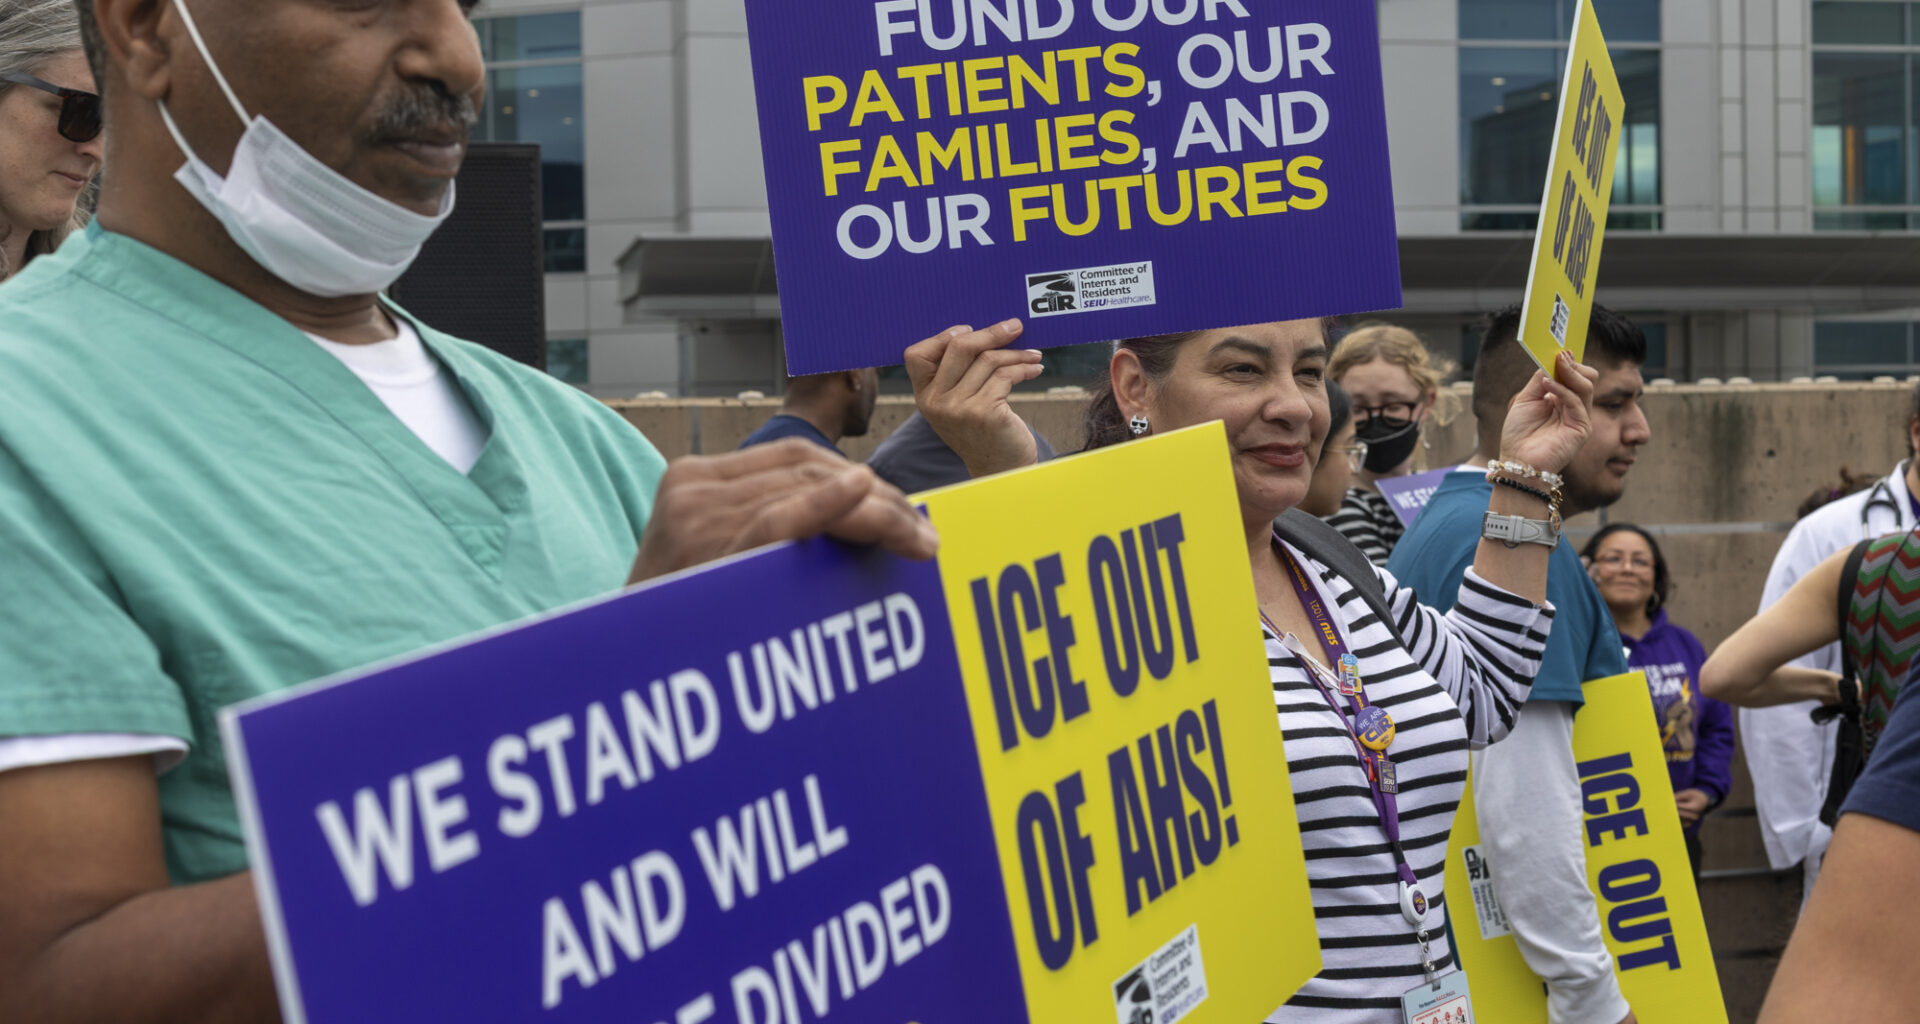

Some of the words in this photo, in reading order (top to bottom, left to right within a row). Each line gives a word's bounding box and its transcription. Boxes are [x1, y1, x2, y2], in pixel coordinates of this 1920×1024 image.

[803, 42, 1161, 131] PATIENTS,
[1178, 22, 1334, 89] OUR
[875, 0, 1075, 56] FUND
[820, 109, 1156, 197] FAMILIES,
[1173, 90, 1330, 158] AND
[1572, 59, 1597, 166] ICE
[1586, 95, 1611, 198] OUT
[836, 193, 994, 259] OUR
[1009, 156, 1329, 242] FUTURES
[1553, 169, 1577, 265] OF
[1564, 193, 1595, 300] AHS!
[1080, 266, 1135, 280] Committee
[1137, 263, 1148, 273] of
[1081, 279, 1117, 290] Interns
[1119, 275, 1139, 285] and
[1081, 286, 1132, 299] Residents
[1393, 491, 1418, 510] WE
[970, 551, 1091, 753] ICE
[1087, 512, 1199, 698] OUT
[315, 755, 480, 906] WE
[487, 669, 720, 837] STAND
[727, 592, 925, 733] UNITED
[1359, 718, 1370, 730] WE
[1370, 708, 1384, 721] ARE
[1016, 770, 1099, 972] OF
[1107, 698, 1240, 918] AHS!
[1576, 752, 1649, 847] ICE
[542, 849, 686, 1009] AND
[692, 774, 848, 911] WILL
[731, 864, 951, 1024] DIVIDED
[1598, 859, 1681, 972] OUT
